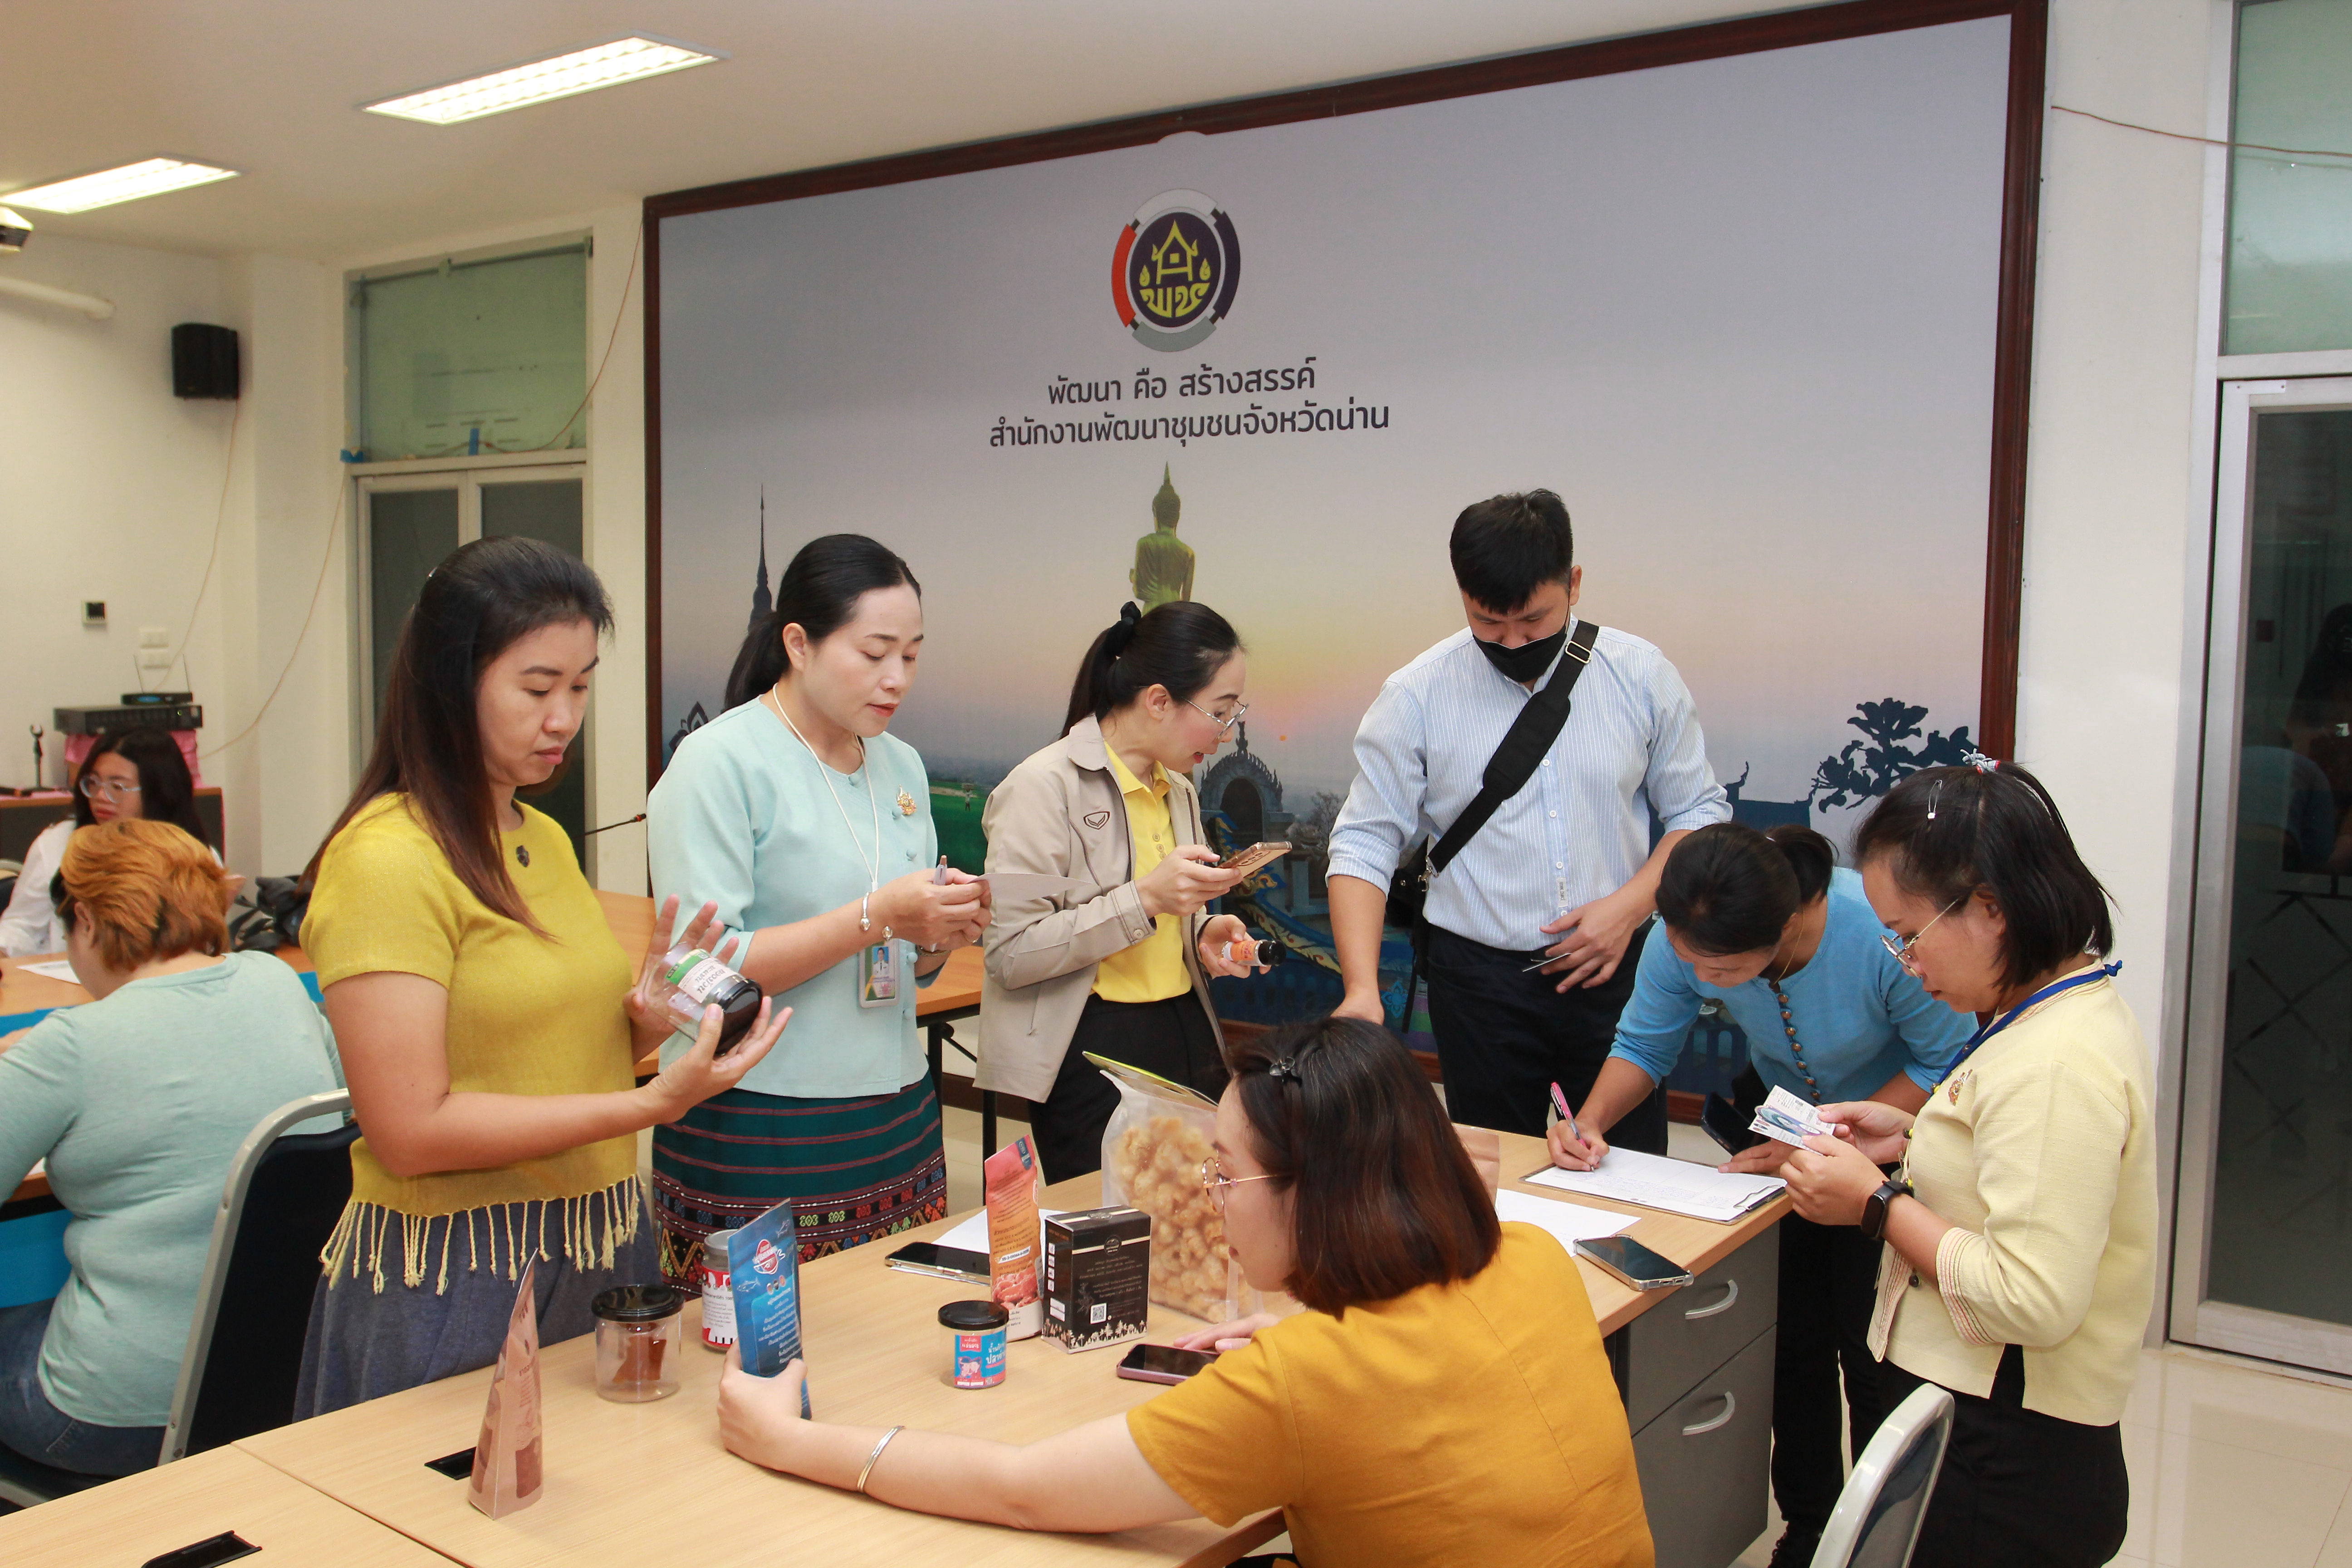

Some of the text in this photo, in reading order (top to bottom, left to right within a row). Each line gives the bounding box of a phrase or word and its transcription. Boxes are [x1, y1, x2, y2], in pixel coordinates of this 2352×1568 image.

[1048, 356, 1317, 405] พัฒนา คือ สร้างสรรค์
[990, 396, 1389, 448] สำนักงานพัฒนาชุมชนจังหวัดน่าน
